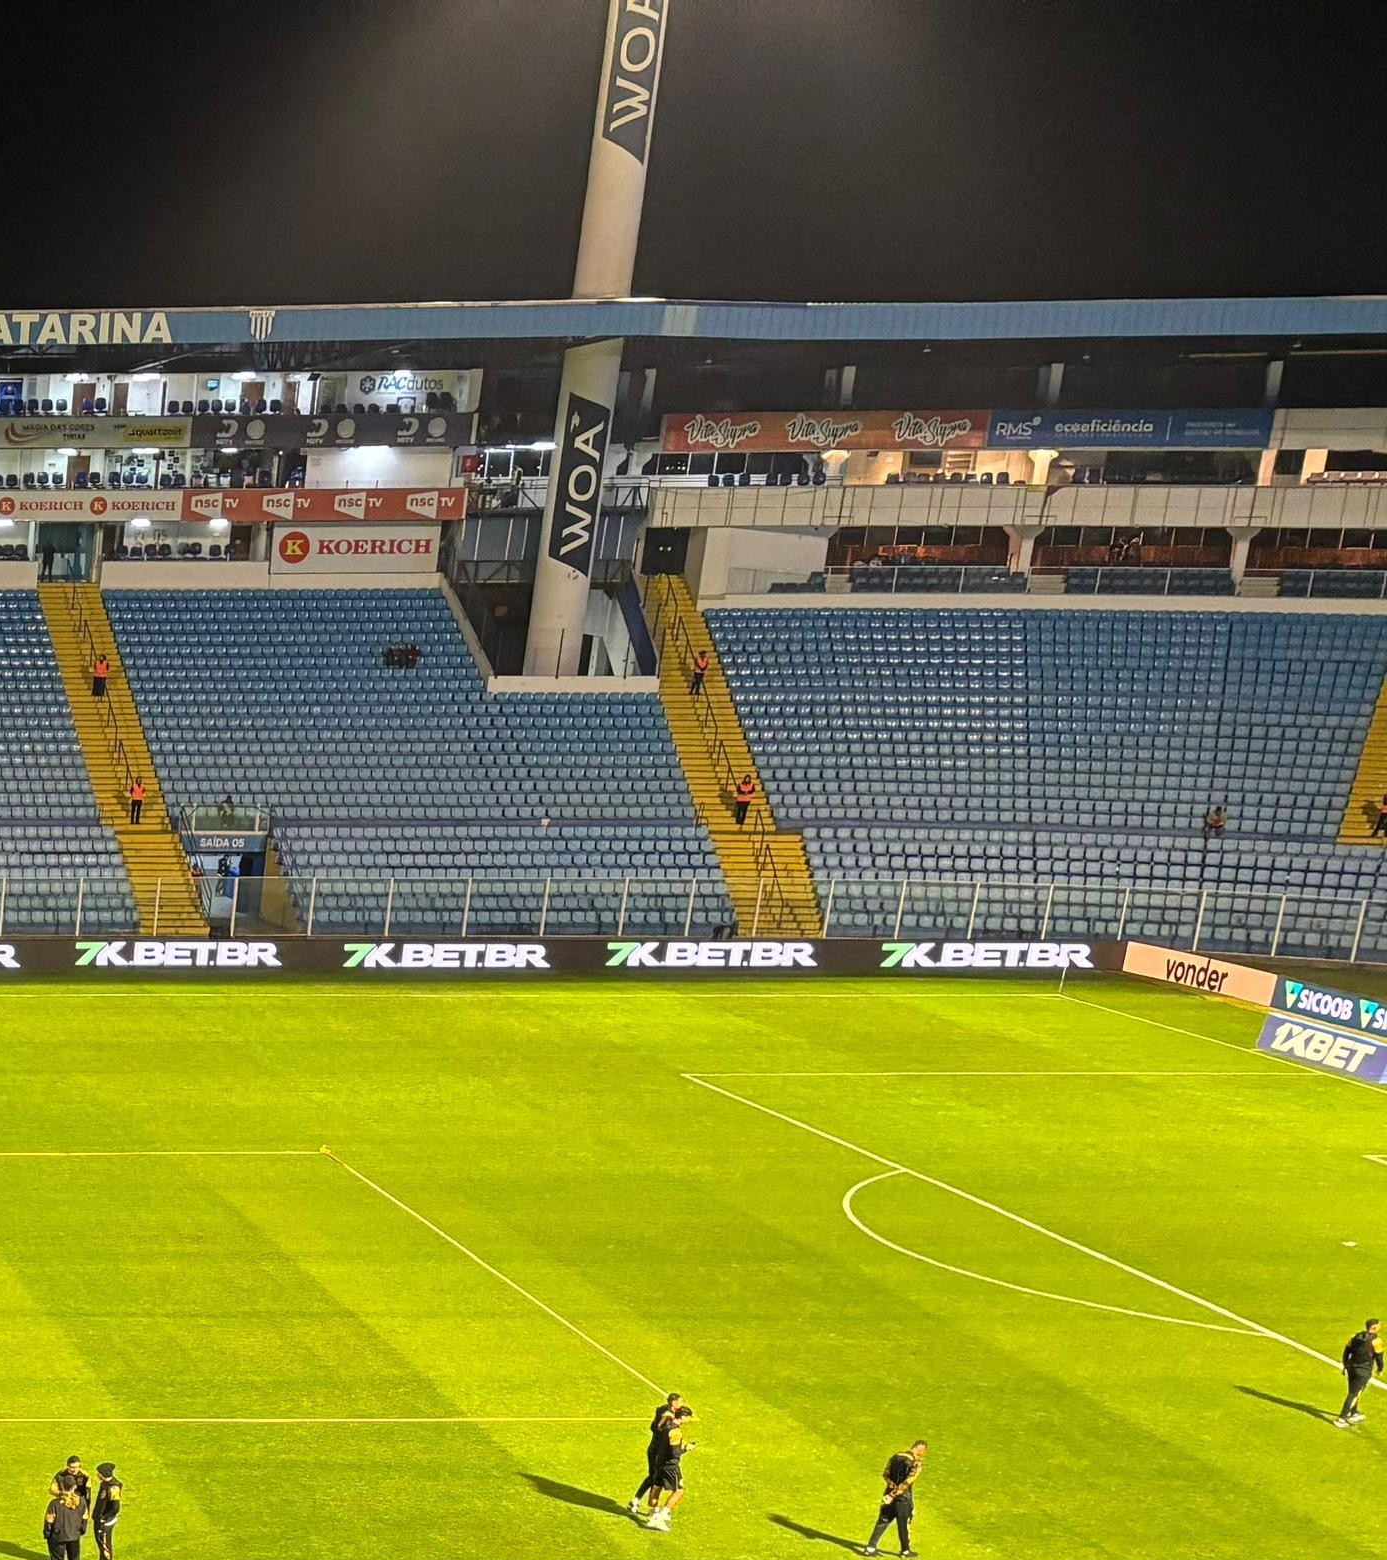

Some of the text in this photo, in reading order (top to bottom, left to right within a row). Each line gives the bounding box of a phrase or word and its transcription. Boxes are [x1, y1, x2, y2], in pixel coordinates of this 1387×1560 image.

[995, 422, 1032, 436] RMS
[559, 420, 604, 556] WOA
[19, 501, 83, 512] KOERICH
[112, 501, 175, 512] KOERICH
[194, 498, 239, 509] nsc TV
[266, 498, 311, 509] nsc TV
[337, 497, 383, 508] nsc TV
[409, 496, 455, 507] nsc TV
[318, 539, 433, 555] KOERICH
[200, 836, 245, 848] SAÍDA 05
[1166, 957, 1228, 994] vonder
[1297, 989, 1354, 1020] SICOOB
[1270, 1022, 1377, 1073] 1XBET
